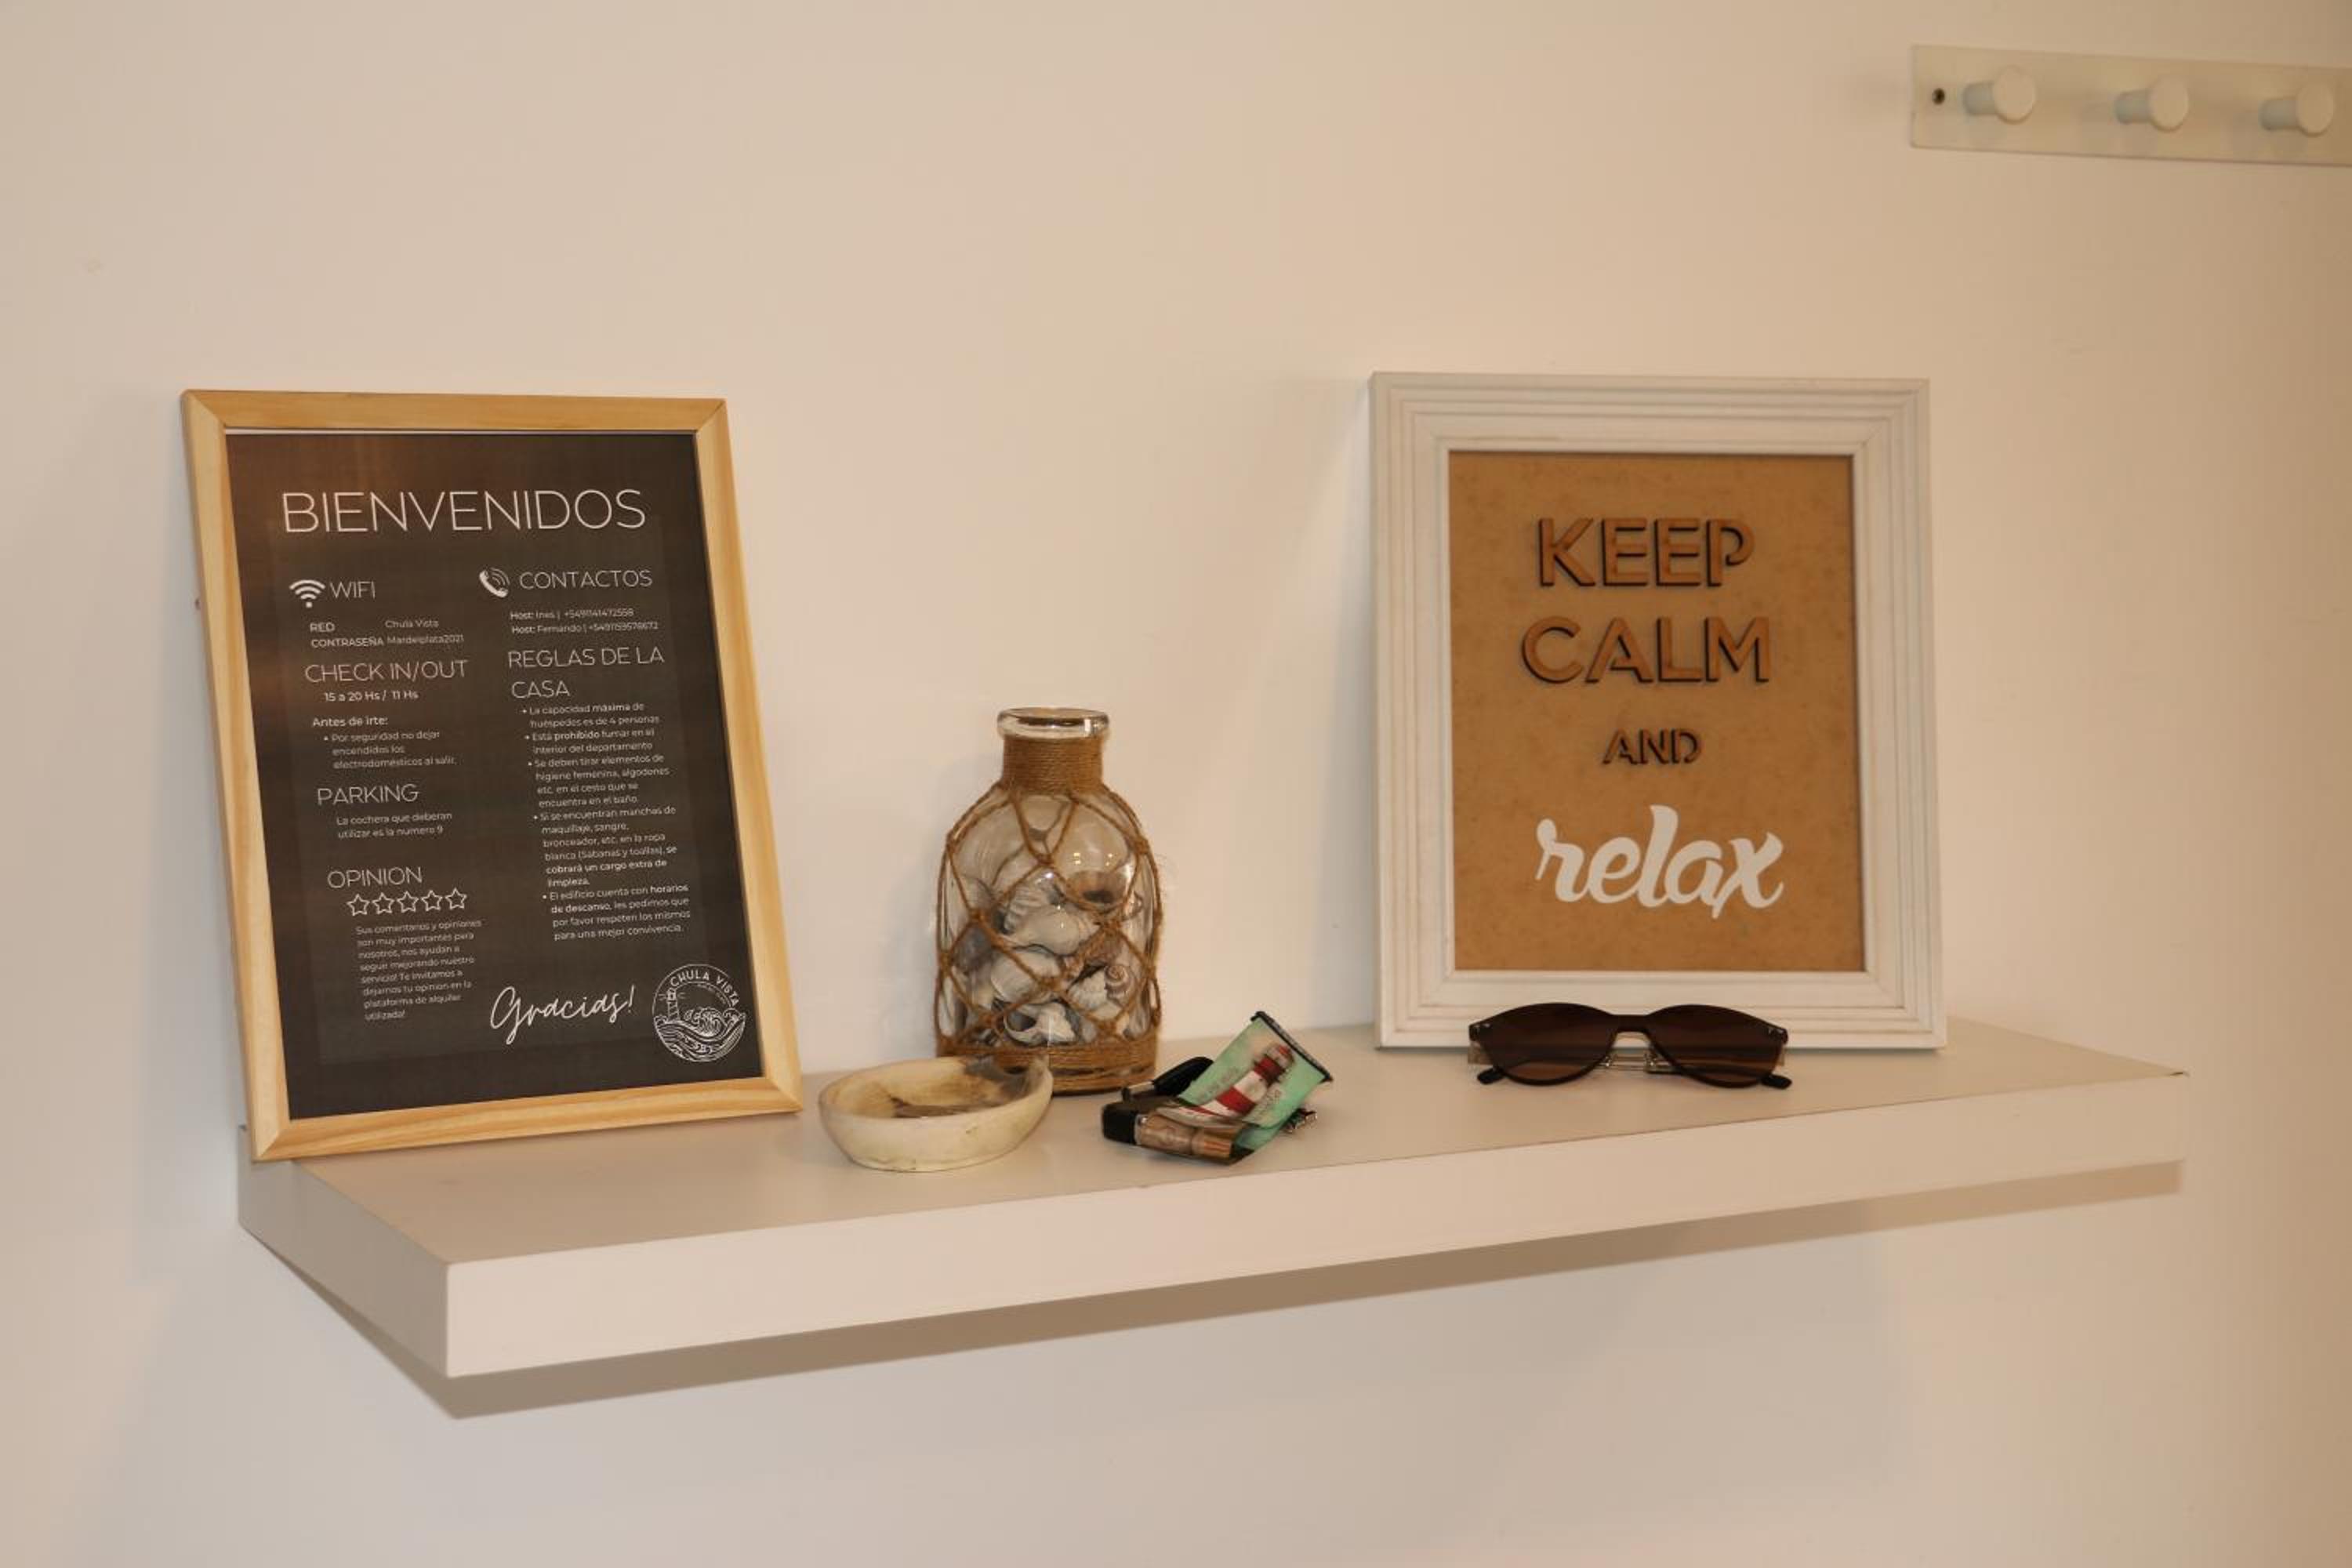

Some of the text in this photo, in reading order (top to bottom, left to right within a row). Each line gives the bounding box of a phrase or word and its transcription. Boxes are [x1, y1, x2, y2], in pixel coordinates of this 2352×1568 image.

[281, 488, 646, 533] BIENVENIDOS
[1537, 517, 1756, 588] KEEP
[520, 570, 653, 590] CONTACTOS
[330, 581, 376, 599] WIFI
[310, 622, 335, 633] RED
[385, 619, 439, 628] Chula Vista
[538, 625, 581, 633] Fernando
[311, 636, 384, 648] CONTRASEÑA
[1521, 615, 1772, 684] CALM
[508, 646, 665, 667] REGLAS DE LA
[305, 659, 468, 683] CHECK IN/OUT
[511, 680, 571, 698] CASA
[325, 692, 336, 702] 15
[347, 691, 362, 702] 20
[404, 690, 419, 699] Hs
[542, 705, 590, 715] capacidad
[632, 702, 644, 711] de
[313, 716, 388, 728] Antes de irte:
[618, 716, 659, 724] personas
[332, 733, 348, 743] Por
[351, 732, 399, 743] seguridad
[416, 730, 440, 740] dejar
[554, 731, 600, 741] prohibido
[601, 729, 630, 738] fumar
[332, 746, 390, 756] encendidos
[534, 742, 652, 754] interior del departamento
[1602, 728, 1703, 765] AND
[425, 757, 434, 765] al
[549, 758, 579, 767] deben
[580, 757, 598, 766] tirar
[601, 755, 651, 764] elementos
[652, 754, 664, 763] de
[535, 772, 572, 783] higiene
[622, 768, 670, 778] algodones
[581, 783, 606, 792] cesto
[608, 782, 625, 792] que
[318, 784, 419, 805] PARKING
[539, 799, 587, 808] encuentra
[563, 809, 617, 819] encuentran
[619, 807, 662, 815] manchas
[336, 817, 348, 826] La
[350, 815, 390, 824] cochera
[392, 814, 410, 824] que
[339, 829, 370, 838] utilizar
[387, 827, 394, 836] la
[437, 826, 443, 834] 9
[545, 852, 576, 862] blanca
[621, 849, 627, 858] y
[1534, 804, 1785, 920] relax
[600, 862, 626, 871] cargo
[328, 867, 423, 888] OPINION
[561, 890, 595, 900] edificio
[597, 888, 629, 897] cuenta
[650, 884, 689, 894] horarios
[551, 905, 564, 913] de
[614, 901, 627, 909] les
[629, 898, 670, 909] pedimos
[671, 897, 689, 906] que
[553, 909, 691, 927] por favor respeten los mismos
[356, 920, 481, 935] Sus comentarios y opiniones
[554, 931, 575, 941] para
[578, 929, 596, 938] una
[598, 927, 626, 938] mejor
[376, 937, 395, 946] muy
[397, 933, 452, 944] importantes
[454, 933, 474, 942] para
[419, 946, 452, 956] ayudan
[390, 958, 439, 970] mejorando
[441, 956, 474, 965] nuestro
[412, 970, 455, 979] invitamos
[402, 985, 413, 993] tu
[464, 980, 472, 989] la
[670, 969, 710, 987] CHULA
[716, 975, 740, 1007] VISTA
[415, 995, 427, 1004] de
[490, 984, 635, 1045] Gracias!
